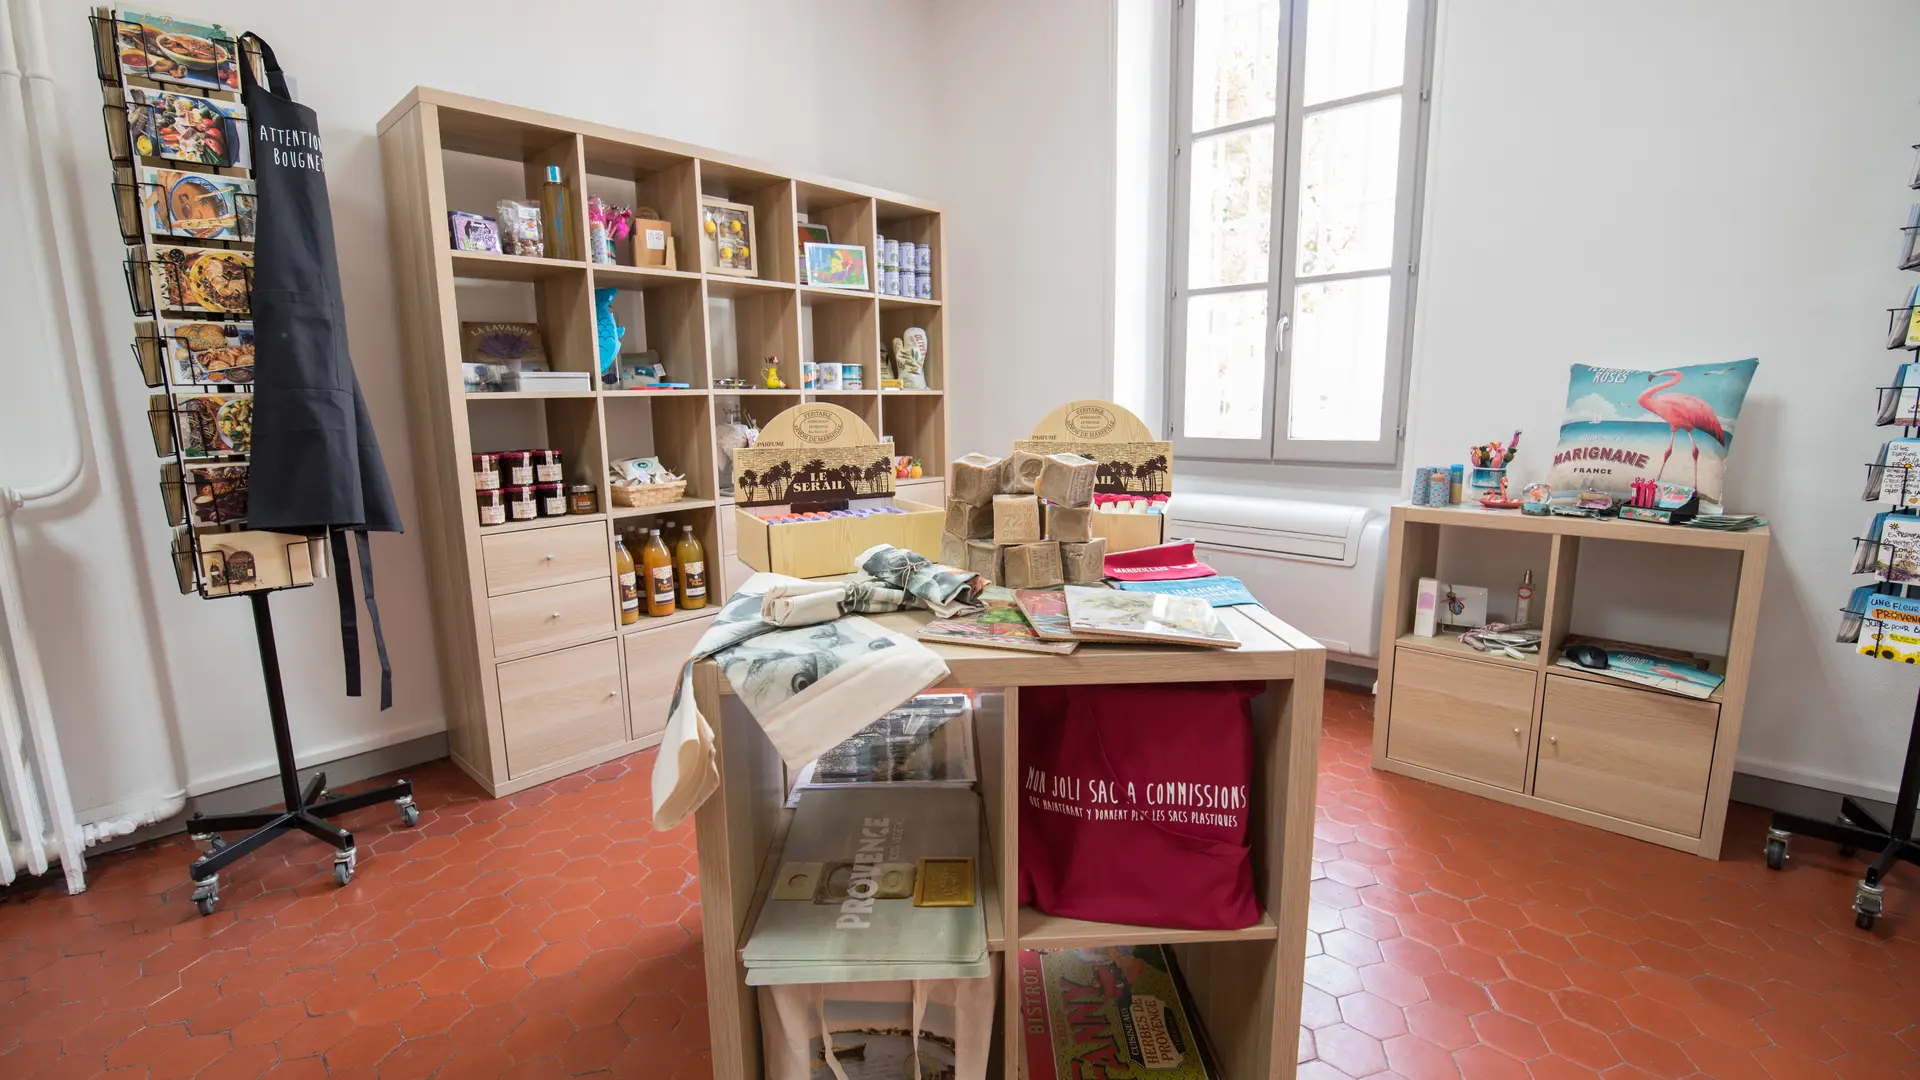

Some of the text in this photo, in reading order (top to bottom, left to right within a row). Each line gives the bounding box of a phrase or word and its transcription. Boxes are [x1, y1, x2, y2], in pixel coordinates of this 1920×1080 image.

[470, 327, 484, 337] LA
[1592, 371, 1628, 384] ROSES
[1553, 446, 1650, 469] MARIGNANE
[1573, 467, 1613, 475] FRANCE
[792, 480, 846, 493] SERAIL
[810, 472, 828, 482] LE
[1113, 566, 1170, 574] MARSEILLAIS
[1025, 765, 1046, 794] MON
[1052, 775, 1080, 801] JOLI
[1088, 779, 1119, 804] SAC
[1146, 781, 1247, 810] COMMISSIONS
[1029, 795, 1041, 809] QUE
[1042, 799, 1084, 818] MAINTENANT
[1086, 808, 1092, 821] Y
[1095, 808, 1128, 821] DONNENT
[1152, 809, 1166, 822] LES
[1168, 810, 1188, 823] SACS
[1191, 811, 1238, 828] PLASTIQUES
[836, 817, 890, 929] PROVENCE
[1022, 967, 1046, 1035] BISTROT
[1121, 1007, 1140, 1056] CUISINE AUX
[1134, 998, 1160, 1065] HERBES DE
[1145, 1000, 1175, 1063] PROVENCE
